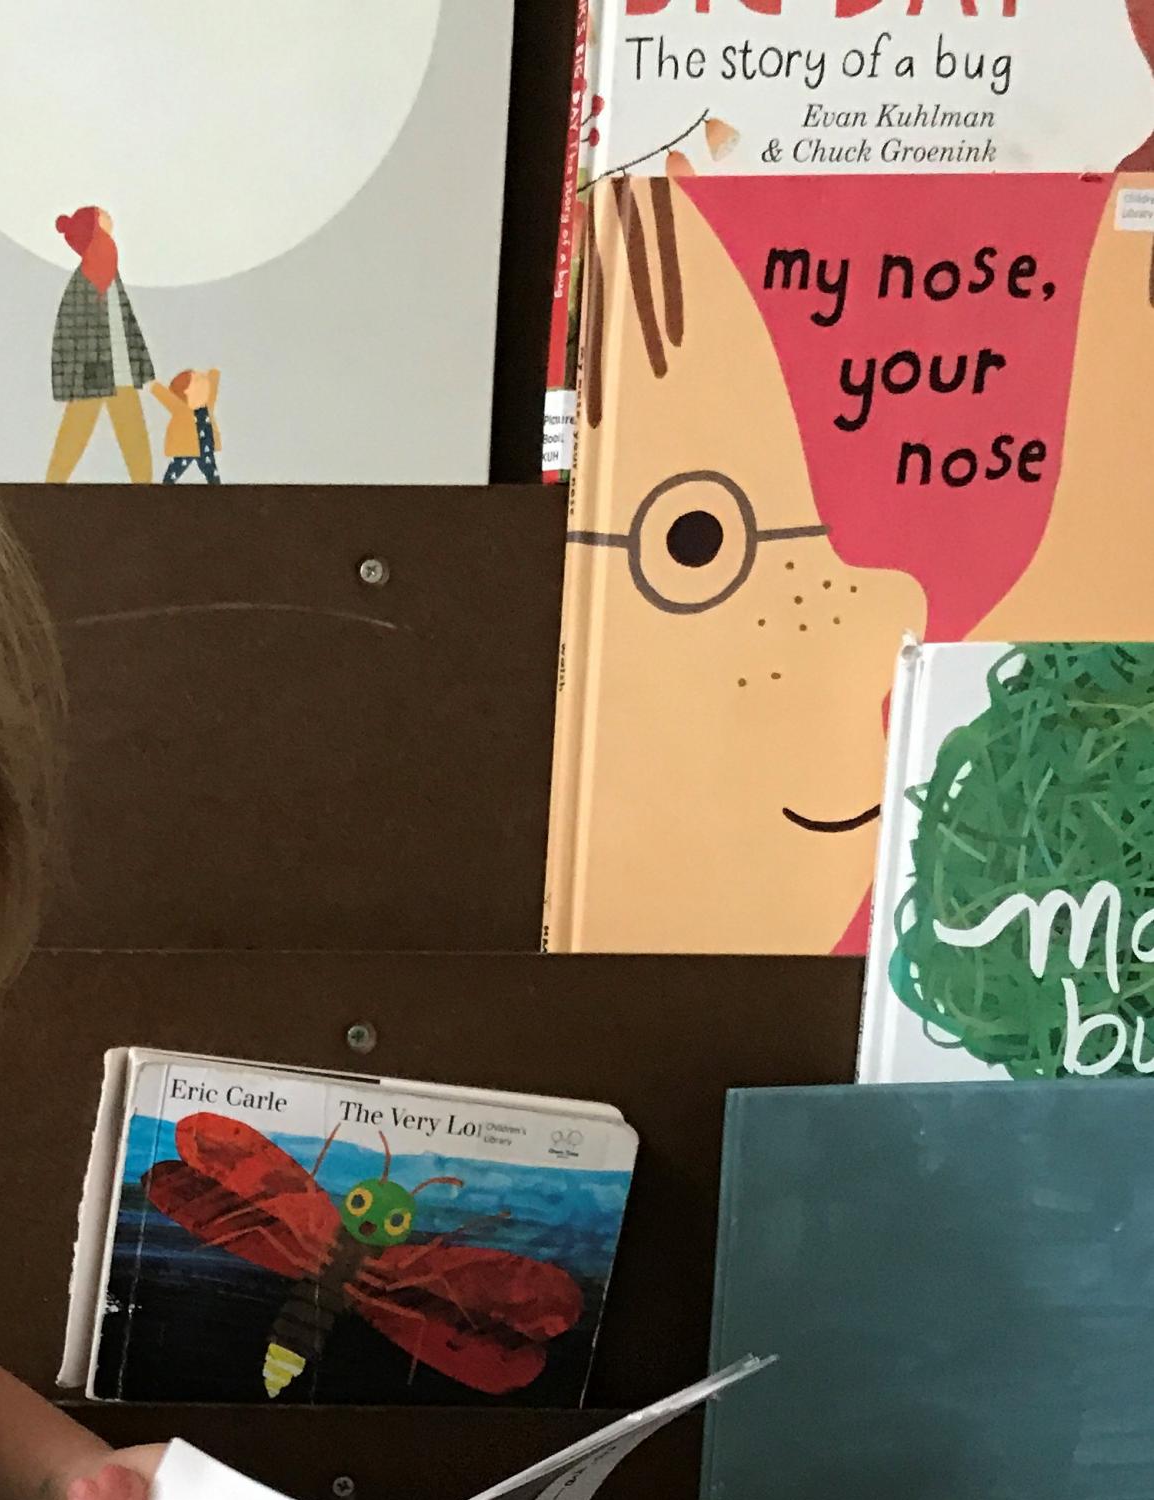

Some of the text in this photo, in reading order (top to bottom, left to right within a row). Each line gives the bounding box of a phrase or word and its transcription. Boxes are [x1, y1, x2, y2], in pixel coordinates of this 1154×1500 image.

[624, 31, 1013, 96] The story of a bug
[802, 103, 996, 129] Evan Kuhlman
[761, 137, 997, 164] & Chuck Groenink
[763, 245, 1057, 327] my nose,
[833, 348, 1007, 432] your
[896, 434, 1046, 488] nose
[169, 1077, 289, 1113] Eric Carle
[340, 1100, 483, 1139] The Very Lo
